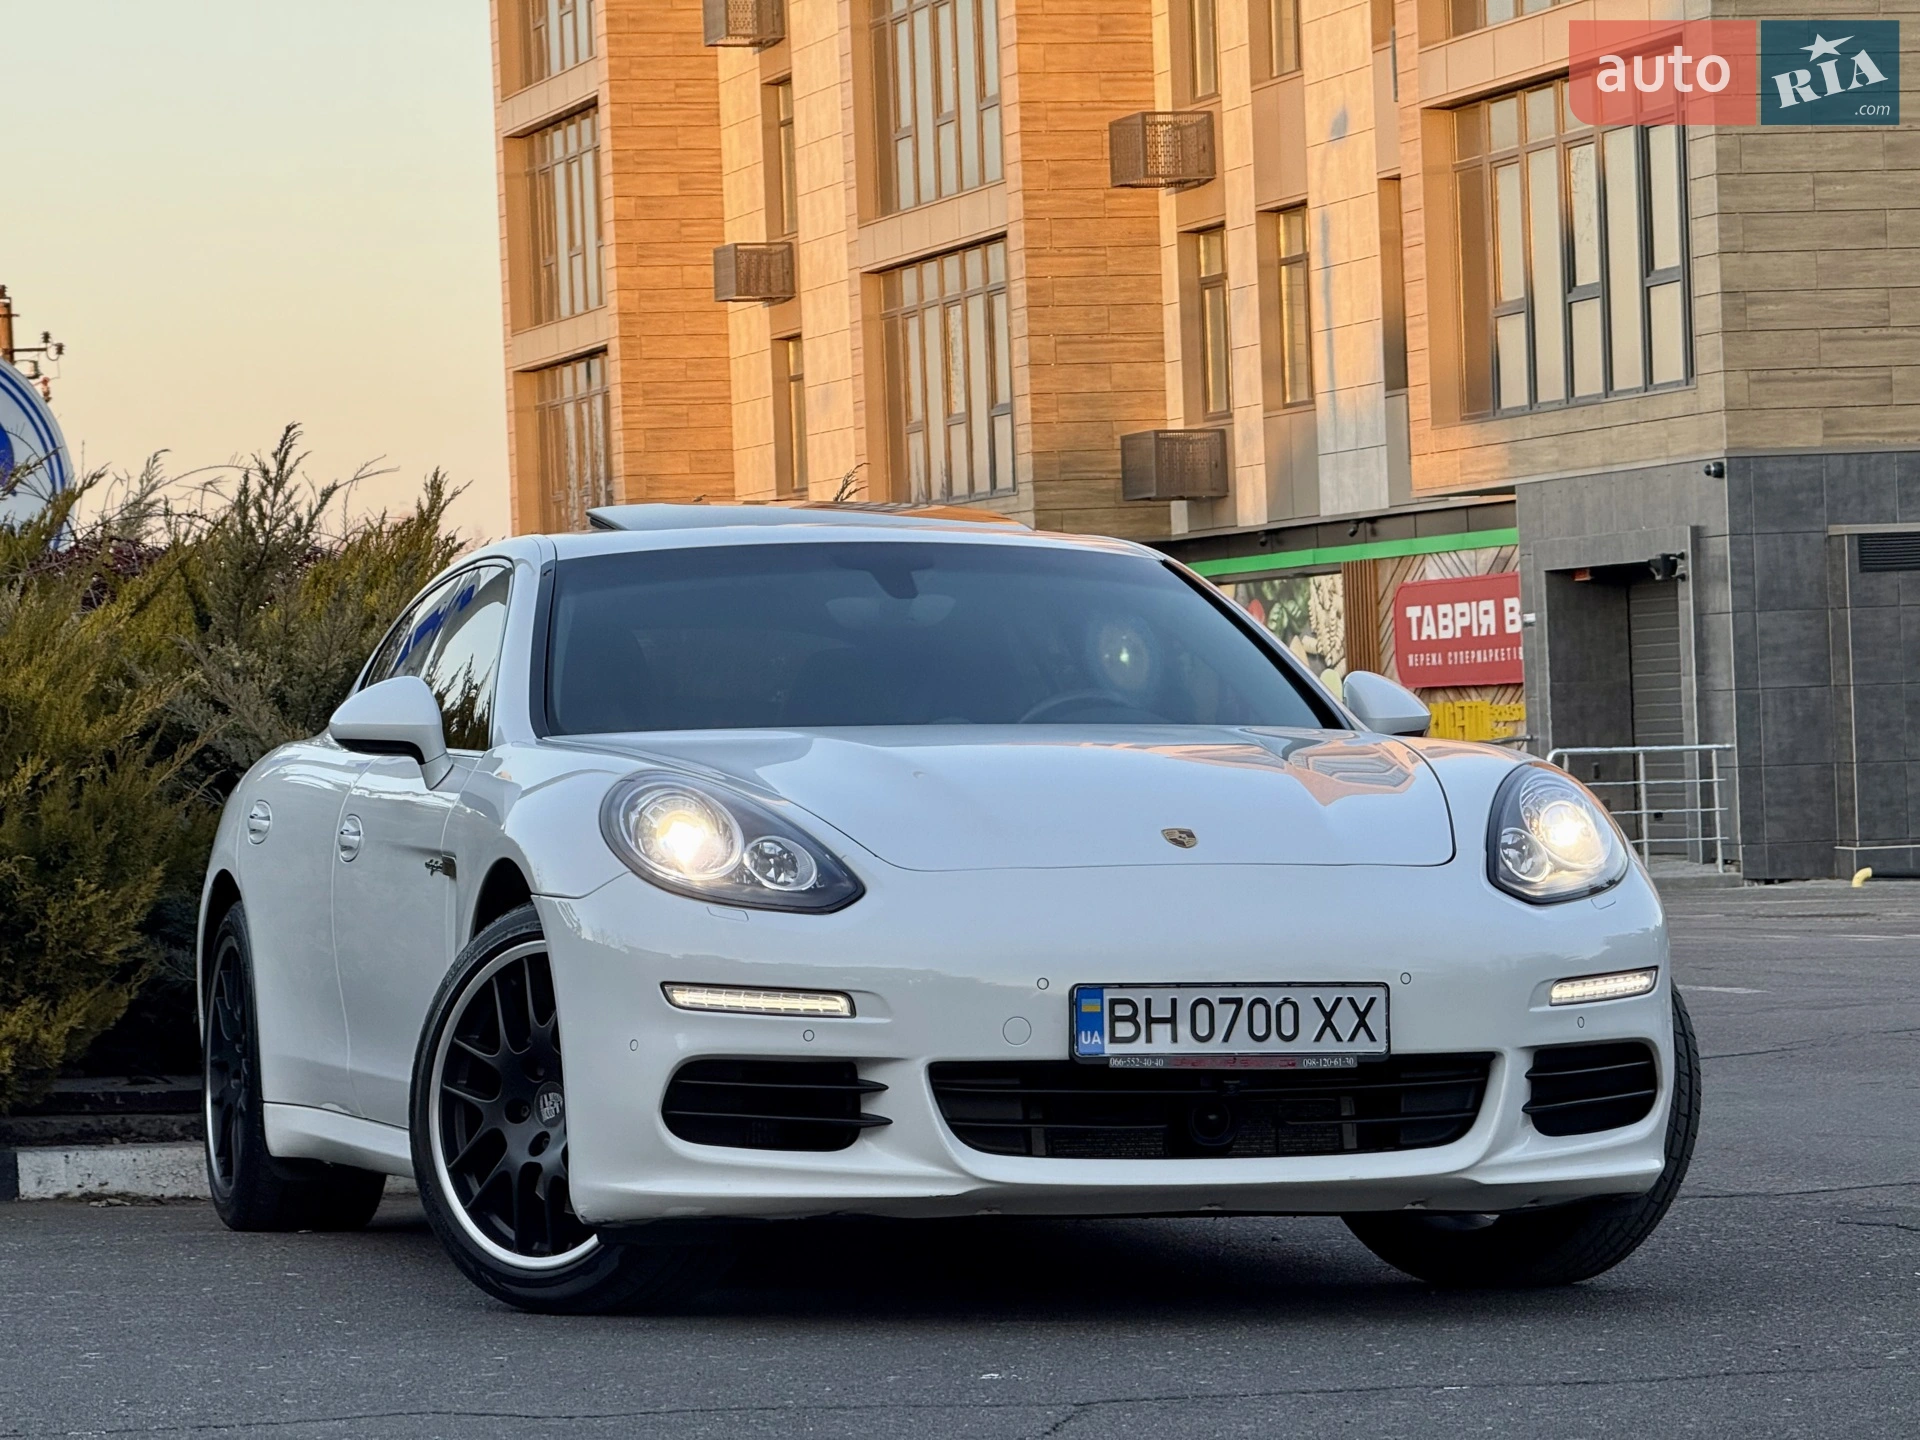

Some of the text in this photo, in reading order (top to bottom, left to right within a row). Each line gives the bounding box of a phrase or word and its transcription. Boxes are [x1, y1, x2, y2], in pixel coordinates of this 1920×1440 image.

[1405, 599, 1496, 641] ТАВРІЯ
[1407, 652, 1443, 667] МЕРЕЖА
[1108, 996, 1378, 1044] BH 0700 XX
[1081, 1030, 1102, 1045] UA
[1109, 1057, 1164, 1068] 066-552-40-40
